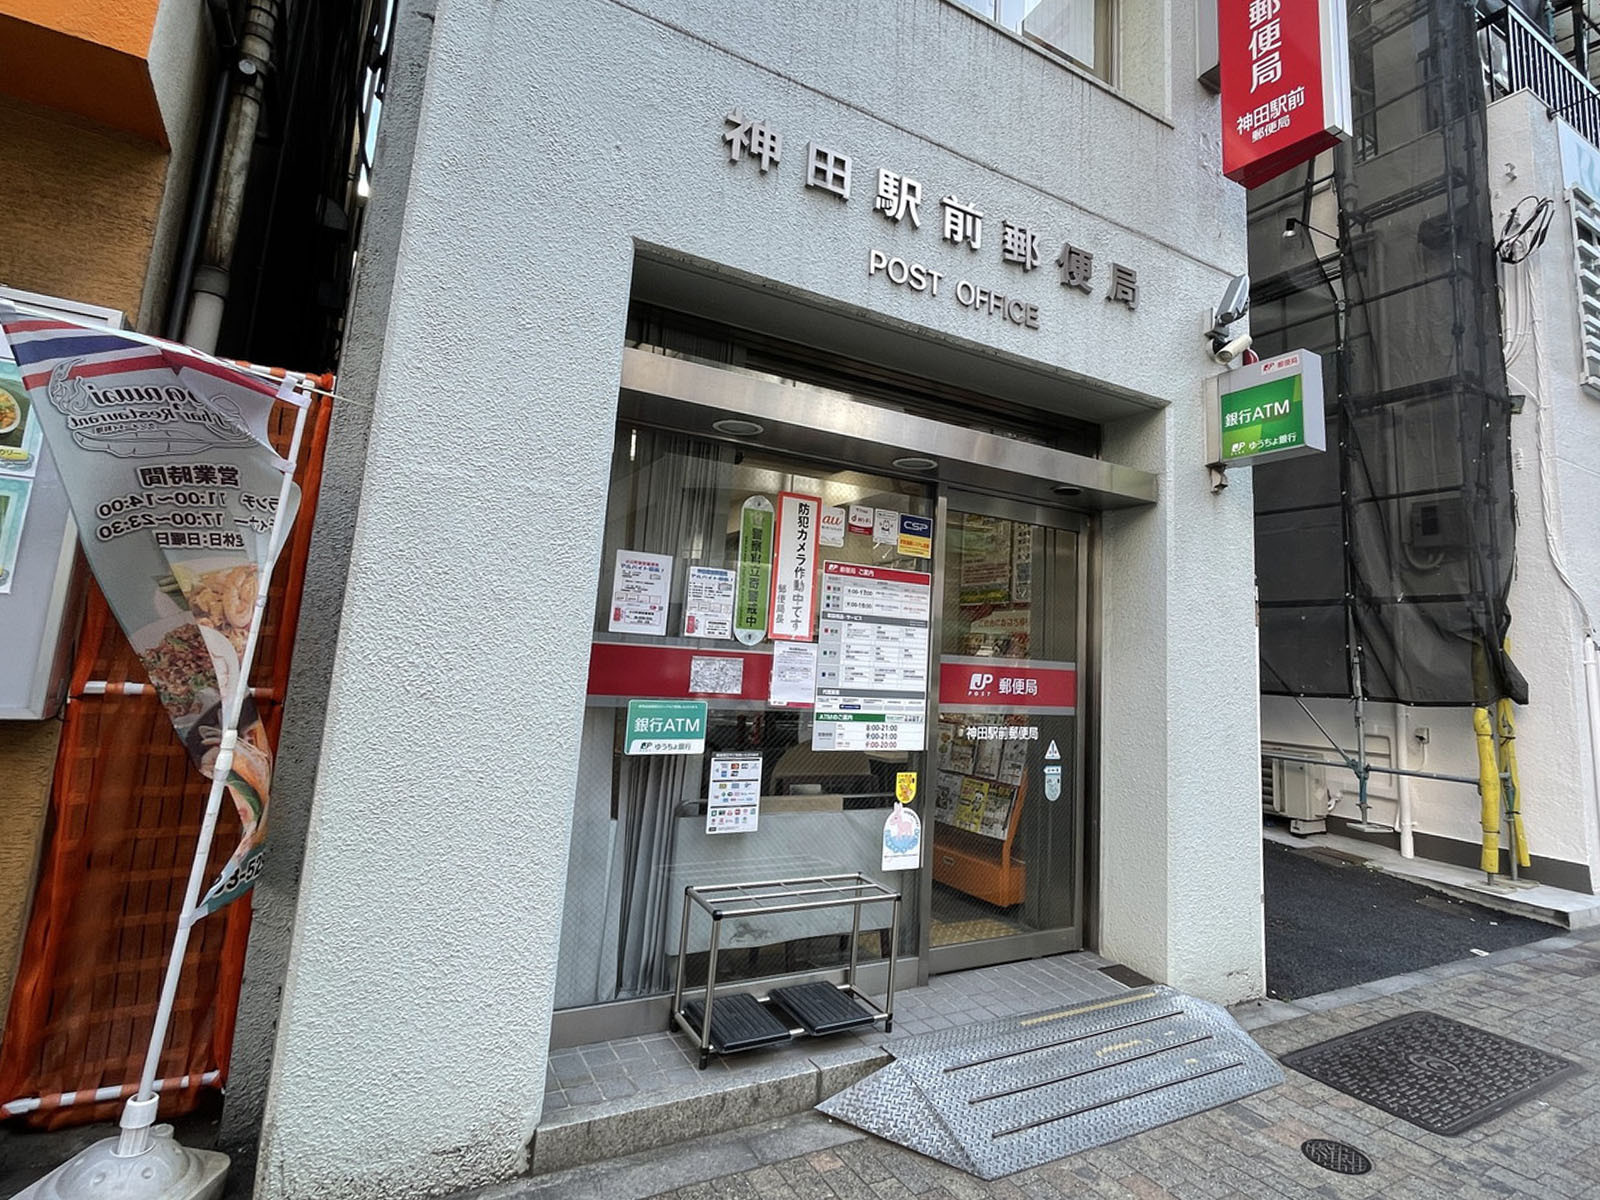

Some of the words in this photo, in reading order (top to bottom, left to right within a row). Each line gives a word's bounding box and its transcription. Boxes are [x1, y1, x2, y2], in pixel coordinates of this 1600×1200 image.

[1248, 0, 1282, 94] 郵便局
[1236, 86, 1305, 135] 神田駅前
[1252, 115, 1291, 143] 郵便局
[722, 109, 1140, 310] 神田駅前郵便局
[869, 248, 943, 296] POST
[956, 281, 1040, 330] OFFICE
[1224, 399, 1290, 428] 銀行ATM
[1248, 432, 1297, 450] ゆうちょ銀行
[822, 515, 842, 526] au
[903, 520, 929, 532] CSP
[790, 502, 811, 632] 防犯カメラ作動中です
[774, 583, 788, 625] 郵便局長
[998, 678, 1038, 696] 郵便局
[633, 717, 700, 733] 銀行ATM
[866, 724, 898, 732] 8:00-21:00
[966, 726, 1039, 741] 神田駅前郵便局
[654, 743, 692, 751] ゆうちょ銀行
